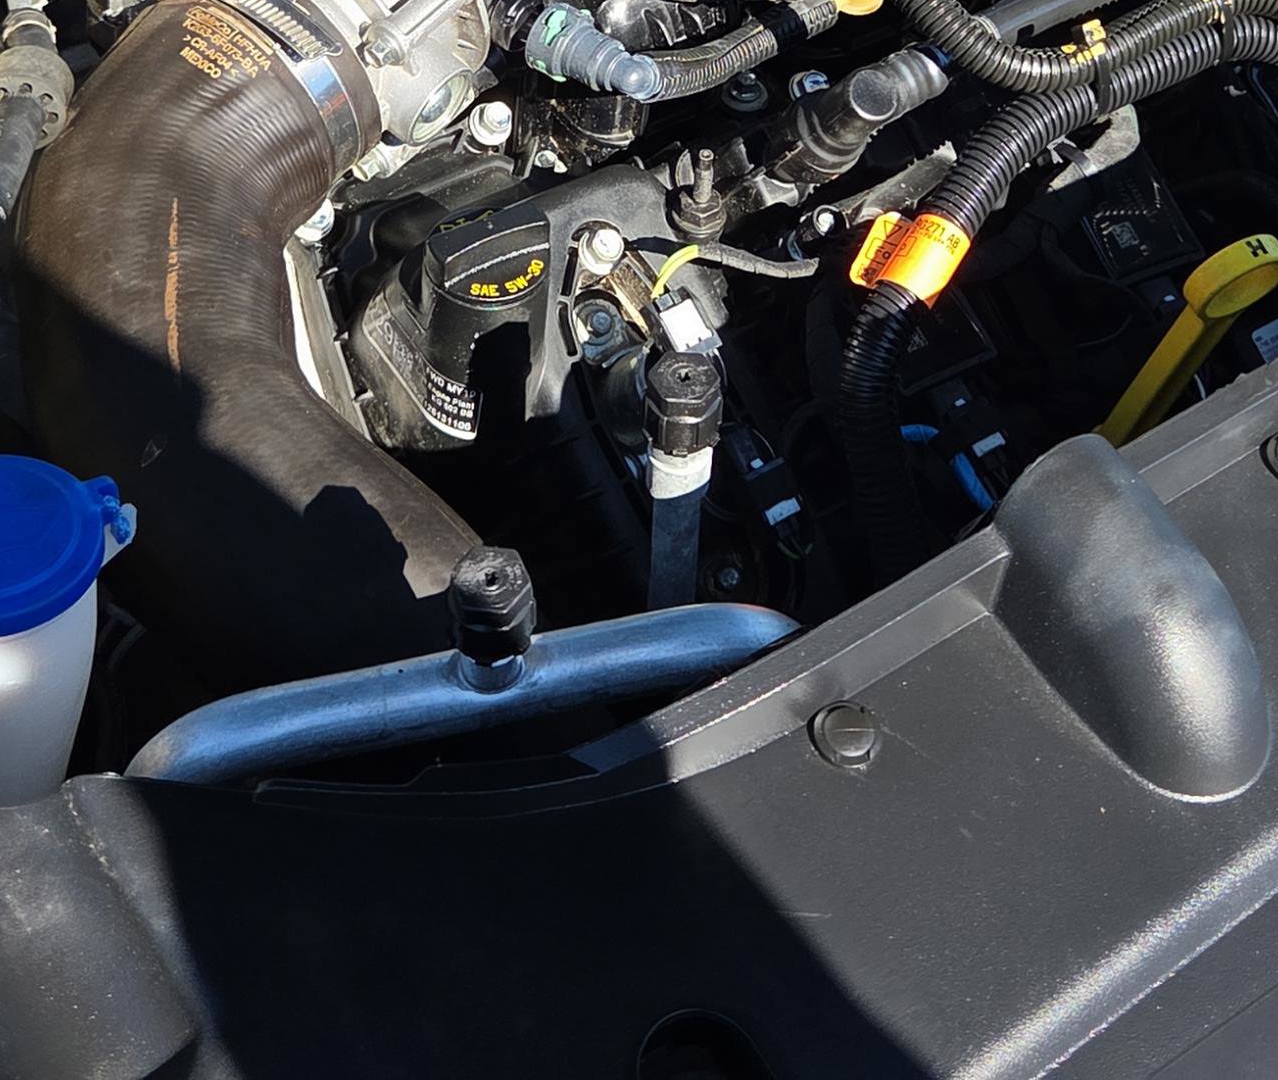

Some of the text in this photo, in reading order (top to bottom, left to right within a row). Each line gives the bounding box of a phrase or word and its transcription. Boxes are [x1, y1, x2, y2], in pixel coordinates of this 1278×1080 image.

[179, 46, 221, 78] MEXICO
[470, 259, 544, 297] SAE 5W-30
